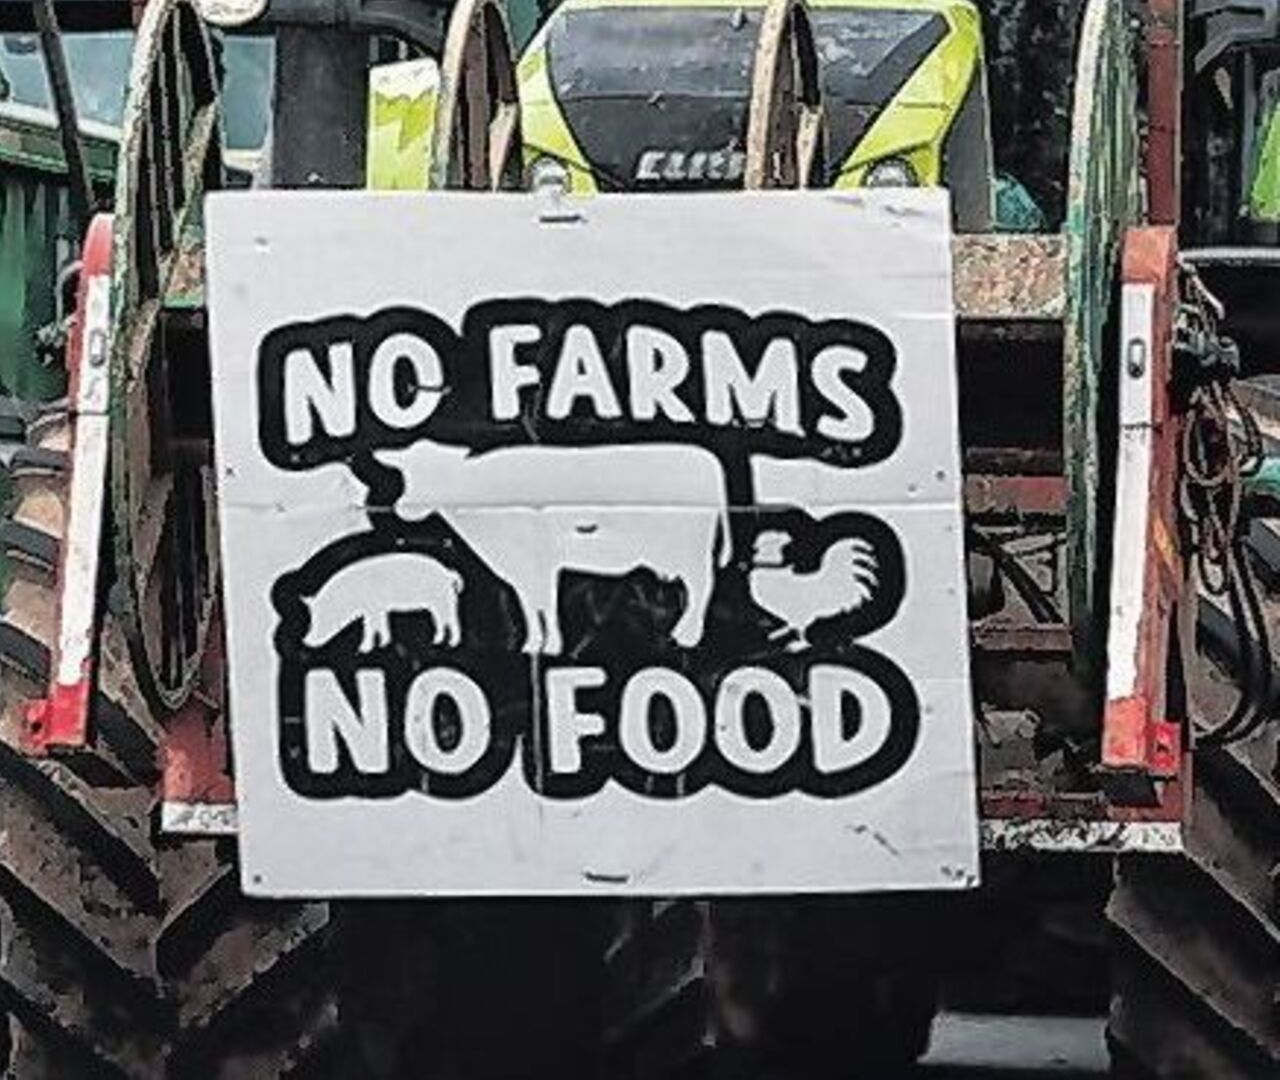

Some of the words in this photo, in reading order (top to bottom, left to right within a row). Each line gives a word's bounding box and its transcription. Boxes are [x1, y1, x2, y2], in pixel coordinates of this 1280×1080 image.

[282, 332, 445, 446] NO
[489, 323, 876, 442] FARMS
[304, 667, 492, 774] NO
[547, 663, 893, 775] FOOD
